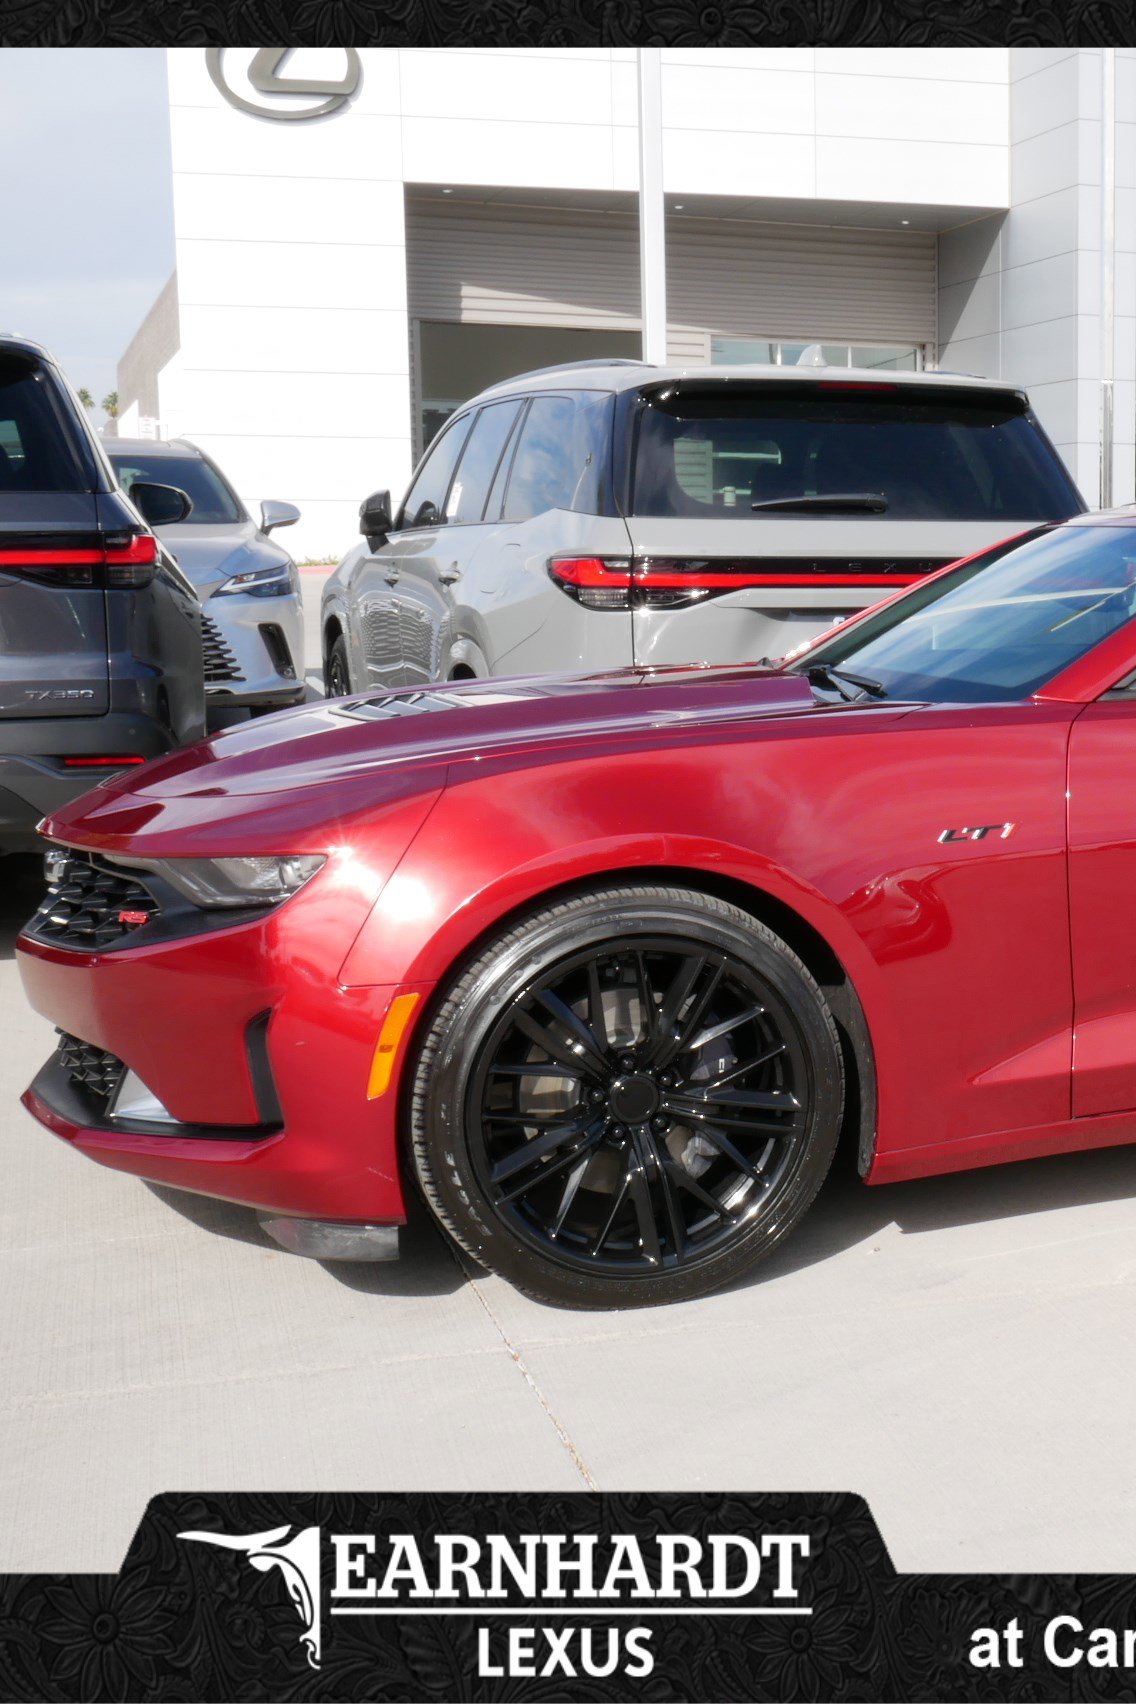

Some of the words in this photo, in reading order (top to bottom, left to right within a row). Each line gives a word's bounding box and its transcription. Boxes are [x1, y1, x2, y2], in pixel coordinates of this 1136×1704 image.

[812, 562, 932, 573] LEXU
[24, 689, 94, 700] TX350
[937, 822, 1016, 844] LT1
